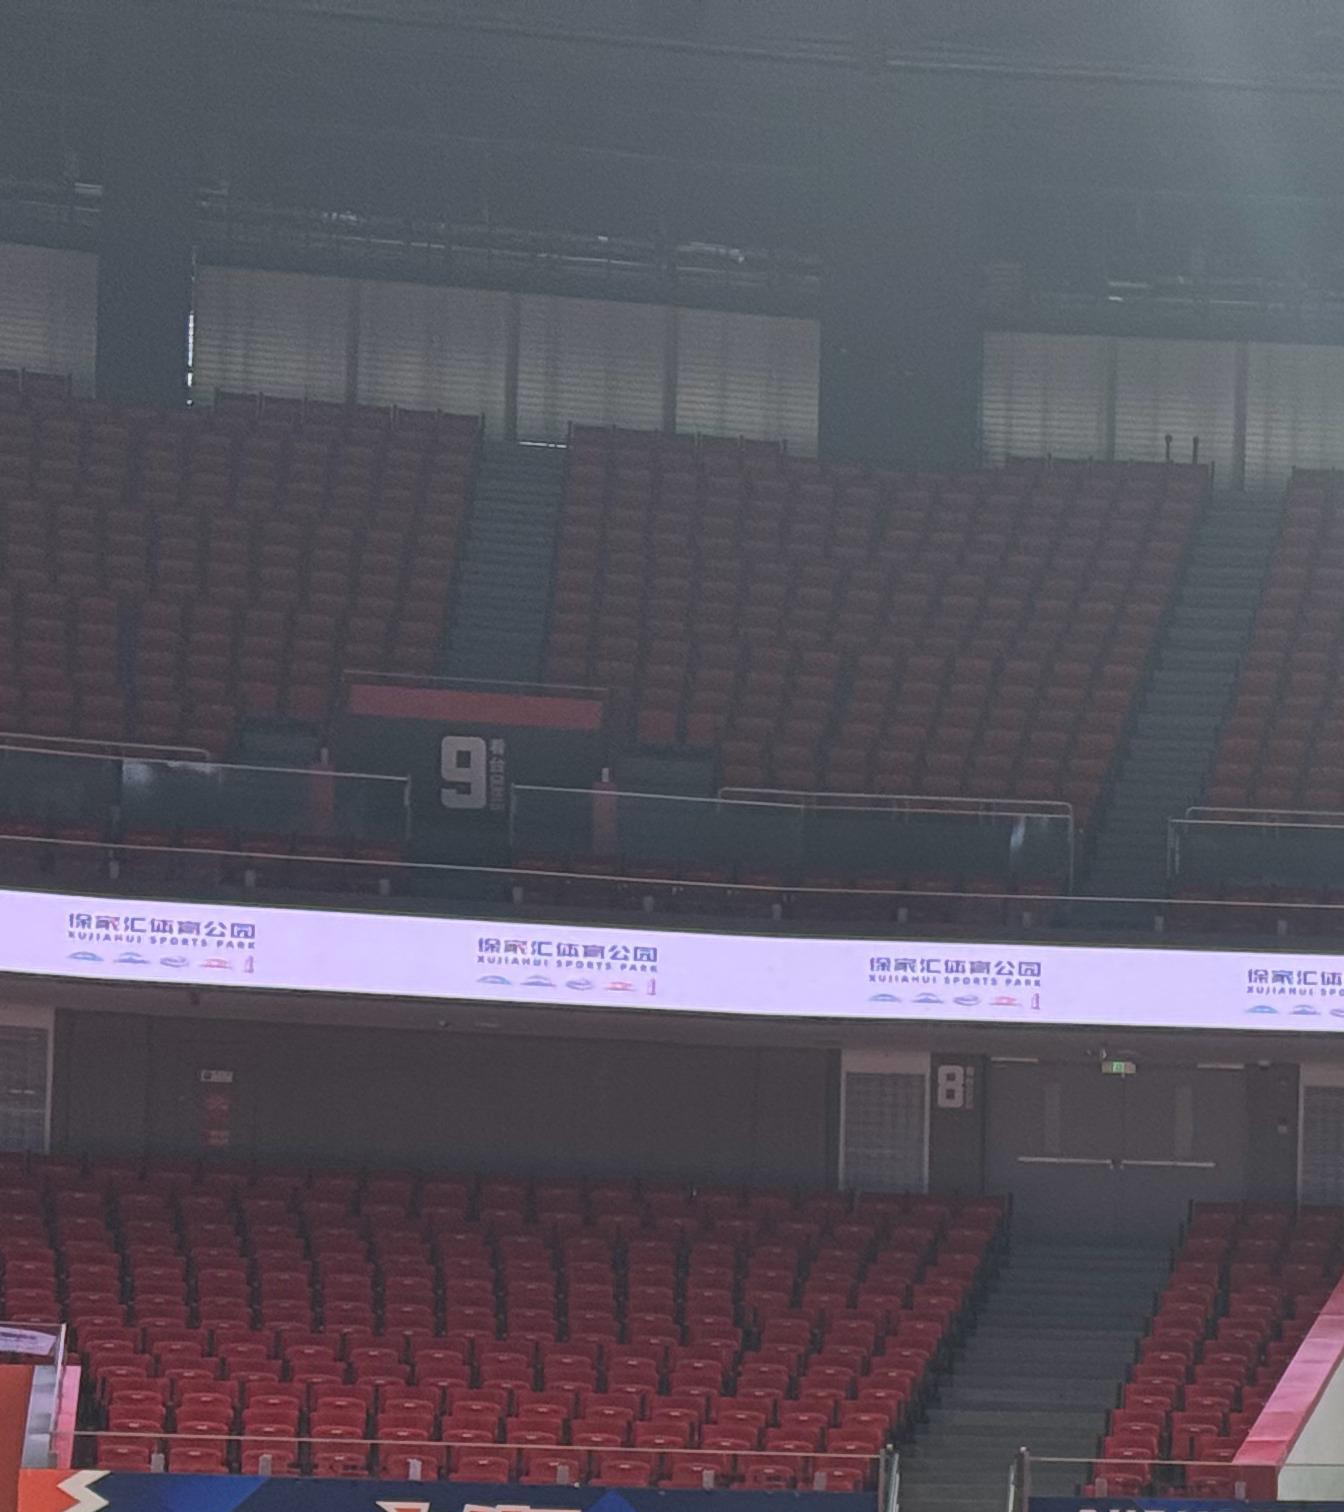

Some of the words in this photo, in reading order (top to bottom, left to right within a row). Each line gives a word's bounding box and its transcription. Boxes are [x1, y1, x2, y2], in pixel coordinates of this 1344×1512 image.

[441, 735, 487, 809] 9
[69, 913, 255, 939] 徐家汇体育公园
[68, 931, 142, 944] XUJIAHUI
[150, 936, 208, 947] SPORTS
[217, 940, 255, 950] PARK
[478, 938, 657, 962] 徐家汇体育公园
[477, 955, 548, 967] XUJIAHUI
[556, 959, 612, 970] SPORTS
[620, 963, 657, 973] PARK
[870, 957, 1041, 977] 徐家汇体育公园
[869, 974, 937, 984] XUJIAHUI
[944, 976, 997, 986] SPORTS
[1005, 978, 1041, 987] PARK
[1247, 986, 1314, 996] XUJIAHUI
[937, 1065, 964, 1108] 8
